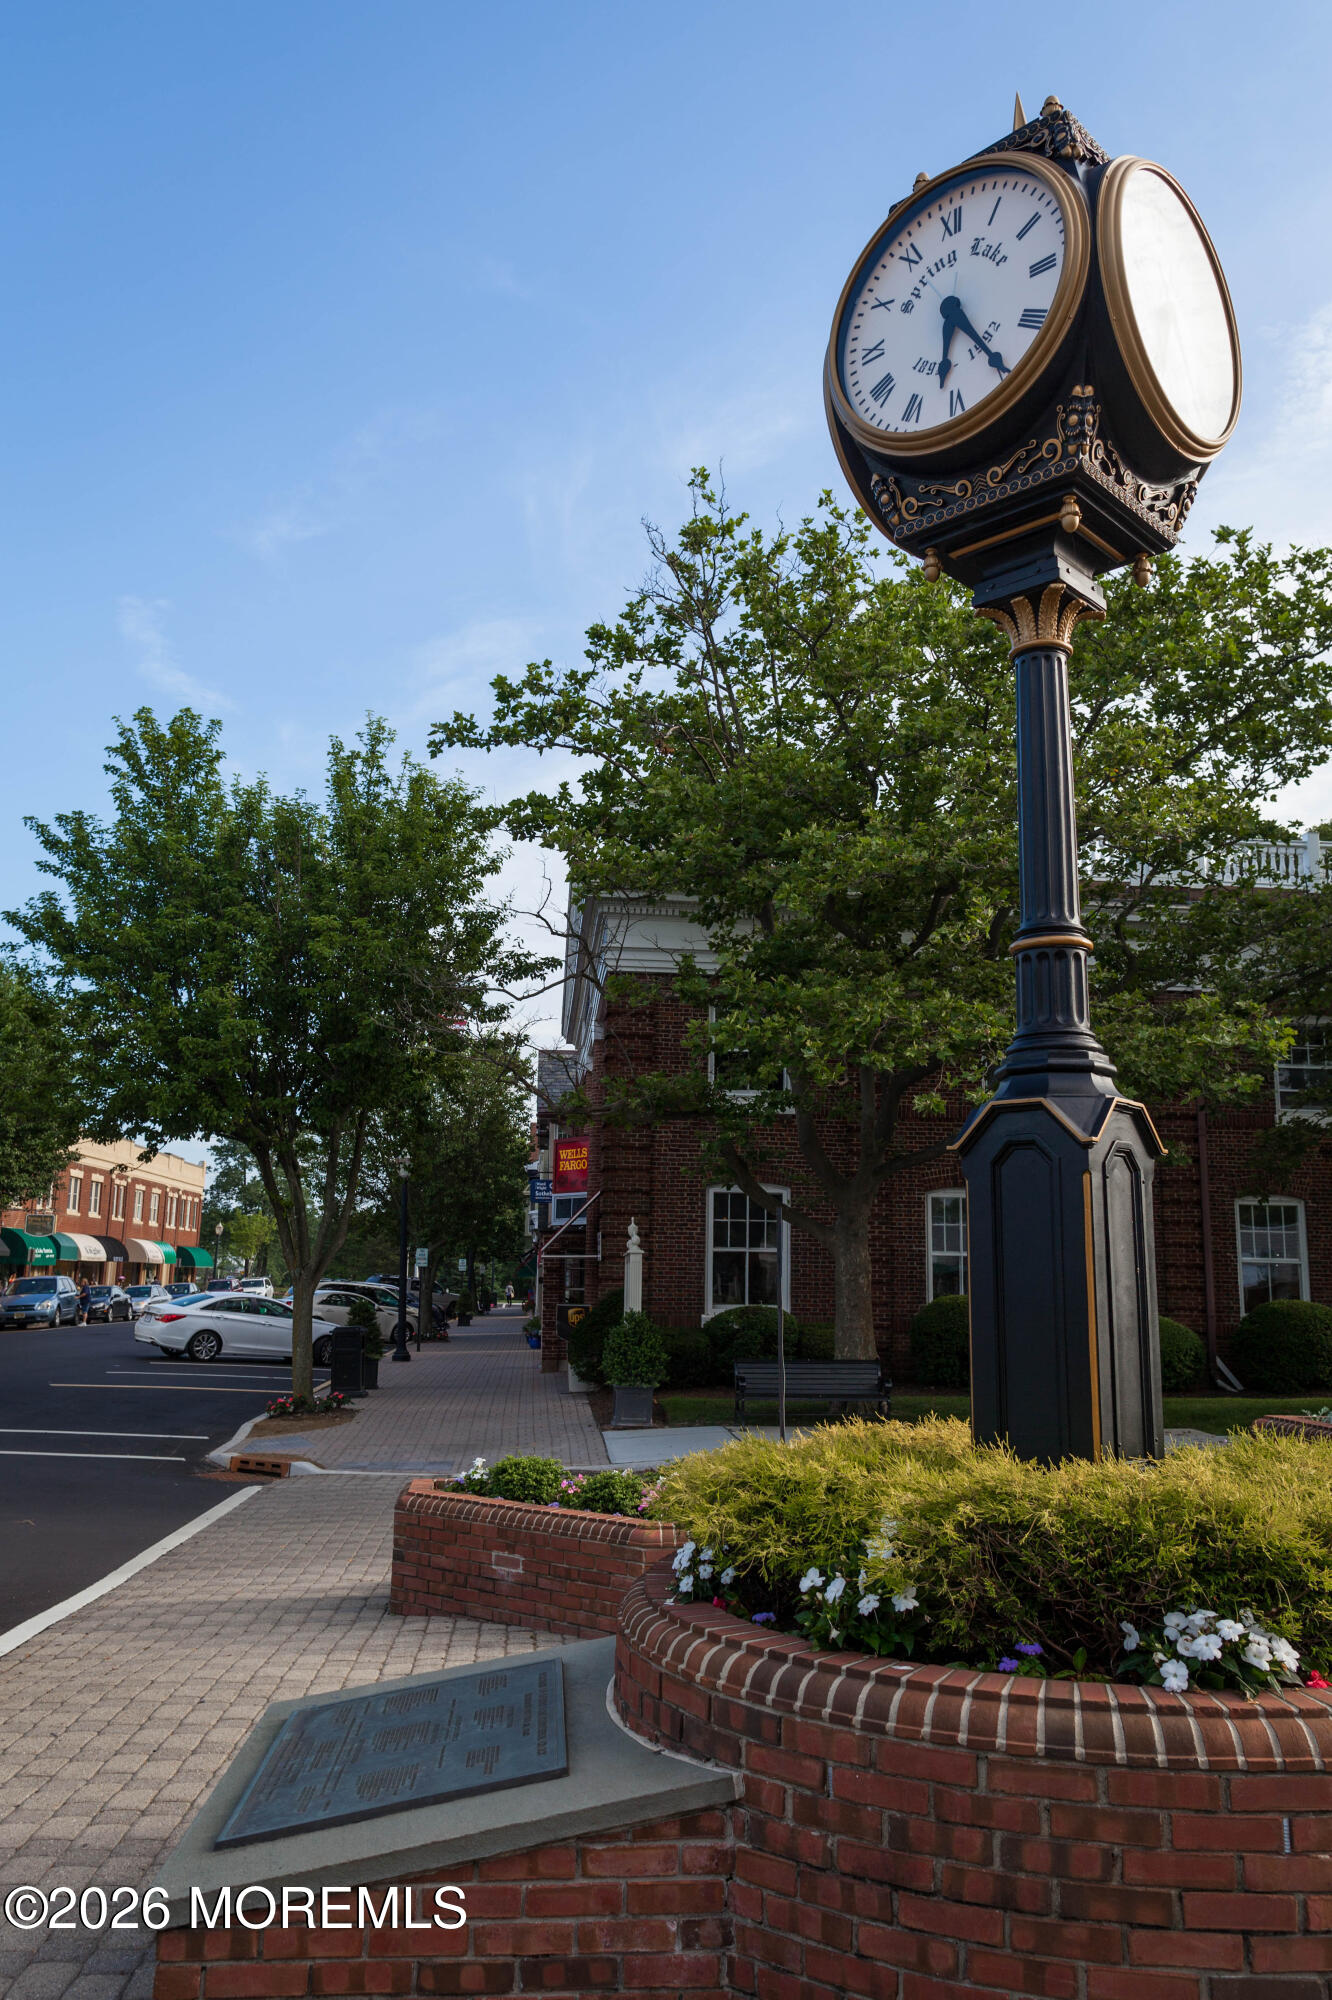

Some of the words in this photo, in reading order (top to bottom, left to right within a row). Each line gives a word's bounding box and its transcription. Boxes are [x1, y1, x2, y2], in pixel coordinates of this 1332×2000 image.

[940, 205, 962, 242] XII
[898, 242, 923, 272] XI
[1029, 253, 1057, 278] III
[901, 249, 958, 315] Spring
[970, 237, 1009, 267] Lake
[870, 297, 895, 312] X
[862, 338, 886, 367] IX
[912, 356, 941, 376] 189
[869, 372, 896, 409] VIII
[949, 388, 966, 417] VI
[901, 392, 923, 424] VII
[559, 1147, 588, 1160] WELLS
[559, 1159, 588, 1172] FARGO
